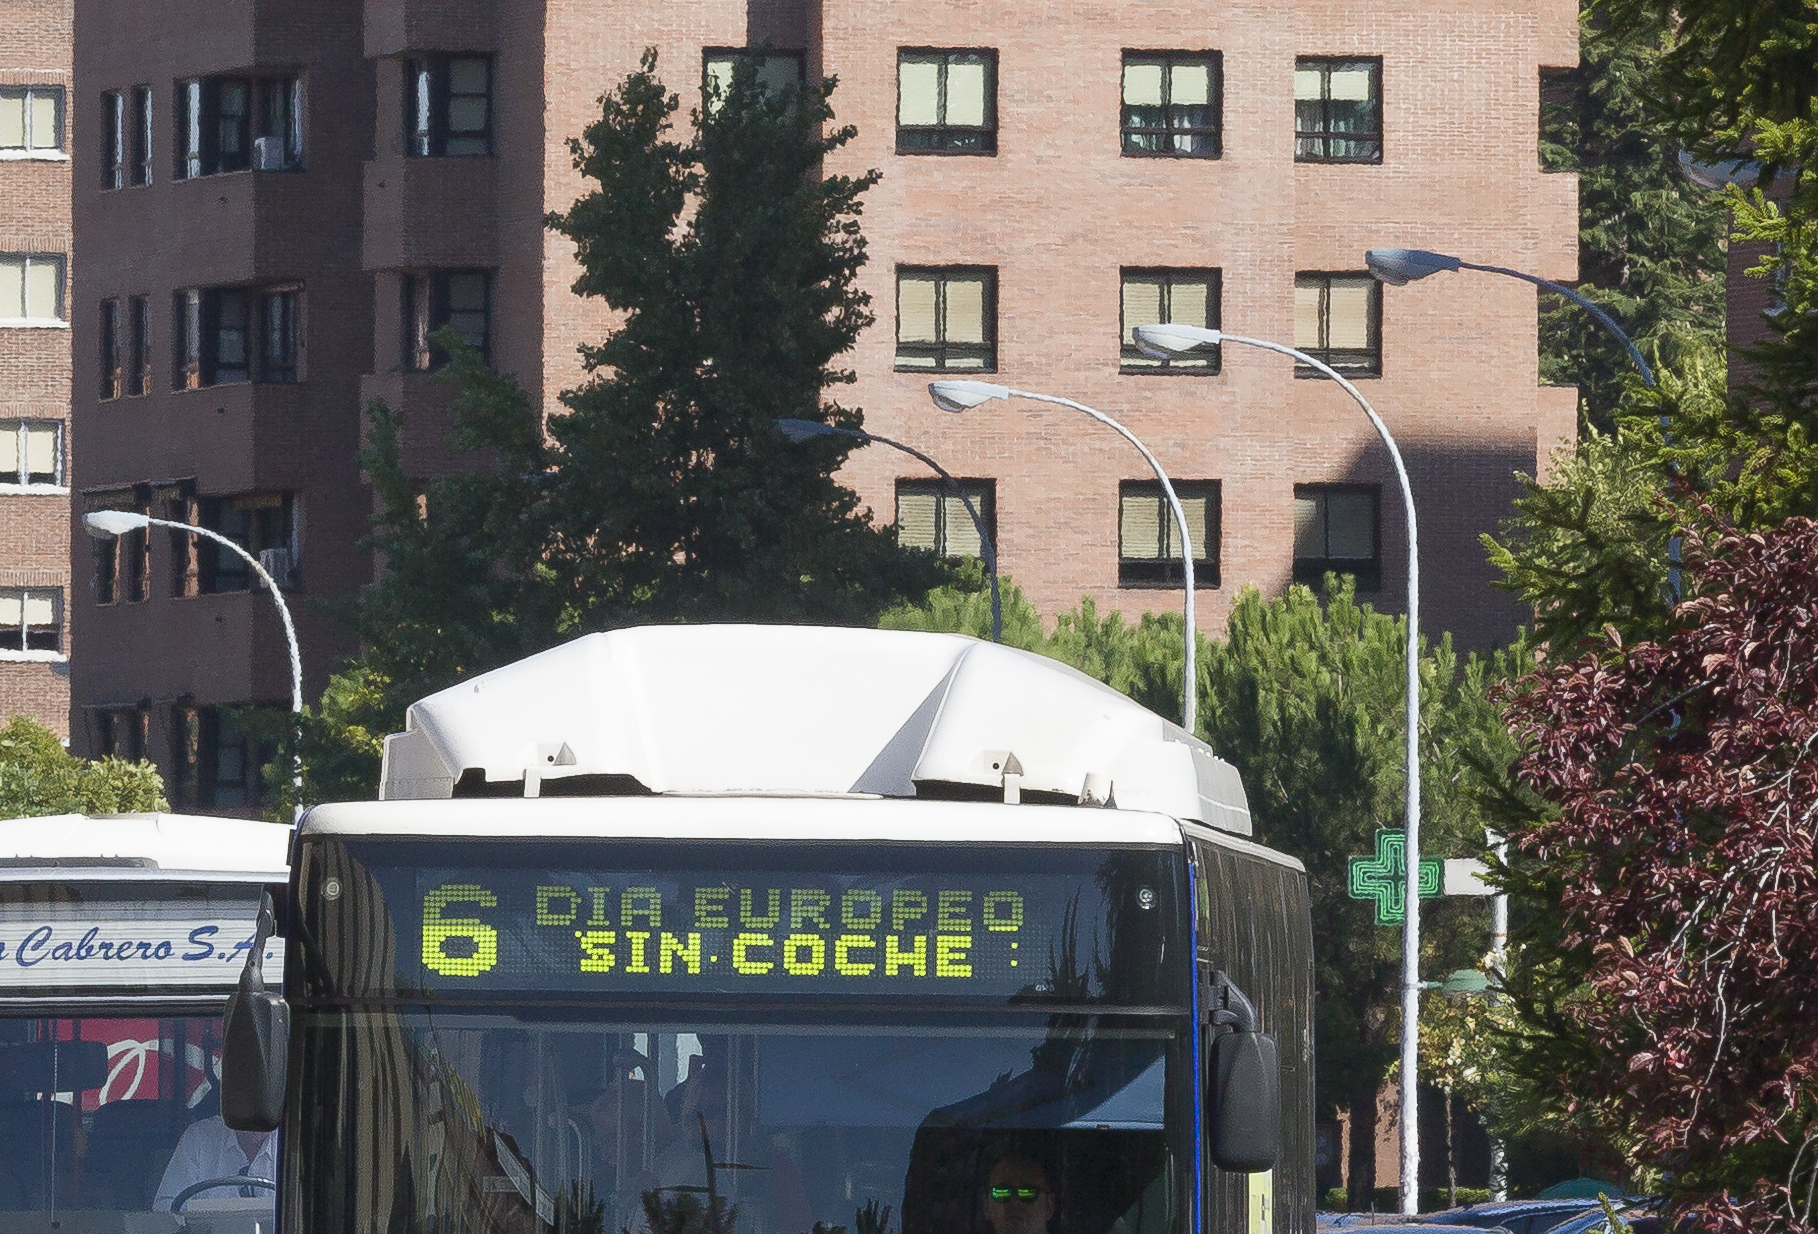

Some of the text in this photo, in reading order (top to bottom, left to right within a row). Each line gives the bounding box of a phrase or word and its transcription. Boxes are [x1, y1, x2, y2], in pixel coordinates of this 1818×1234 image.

[16, 926, 175, 967] Cabrero
[421, 884, 1024, 977] 6 DIA EUROPEO
[732, 933, 972, 978] COCHE
